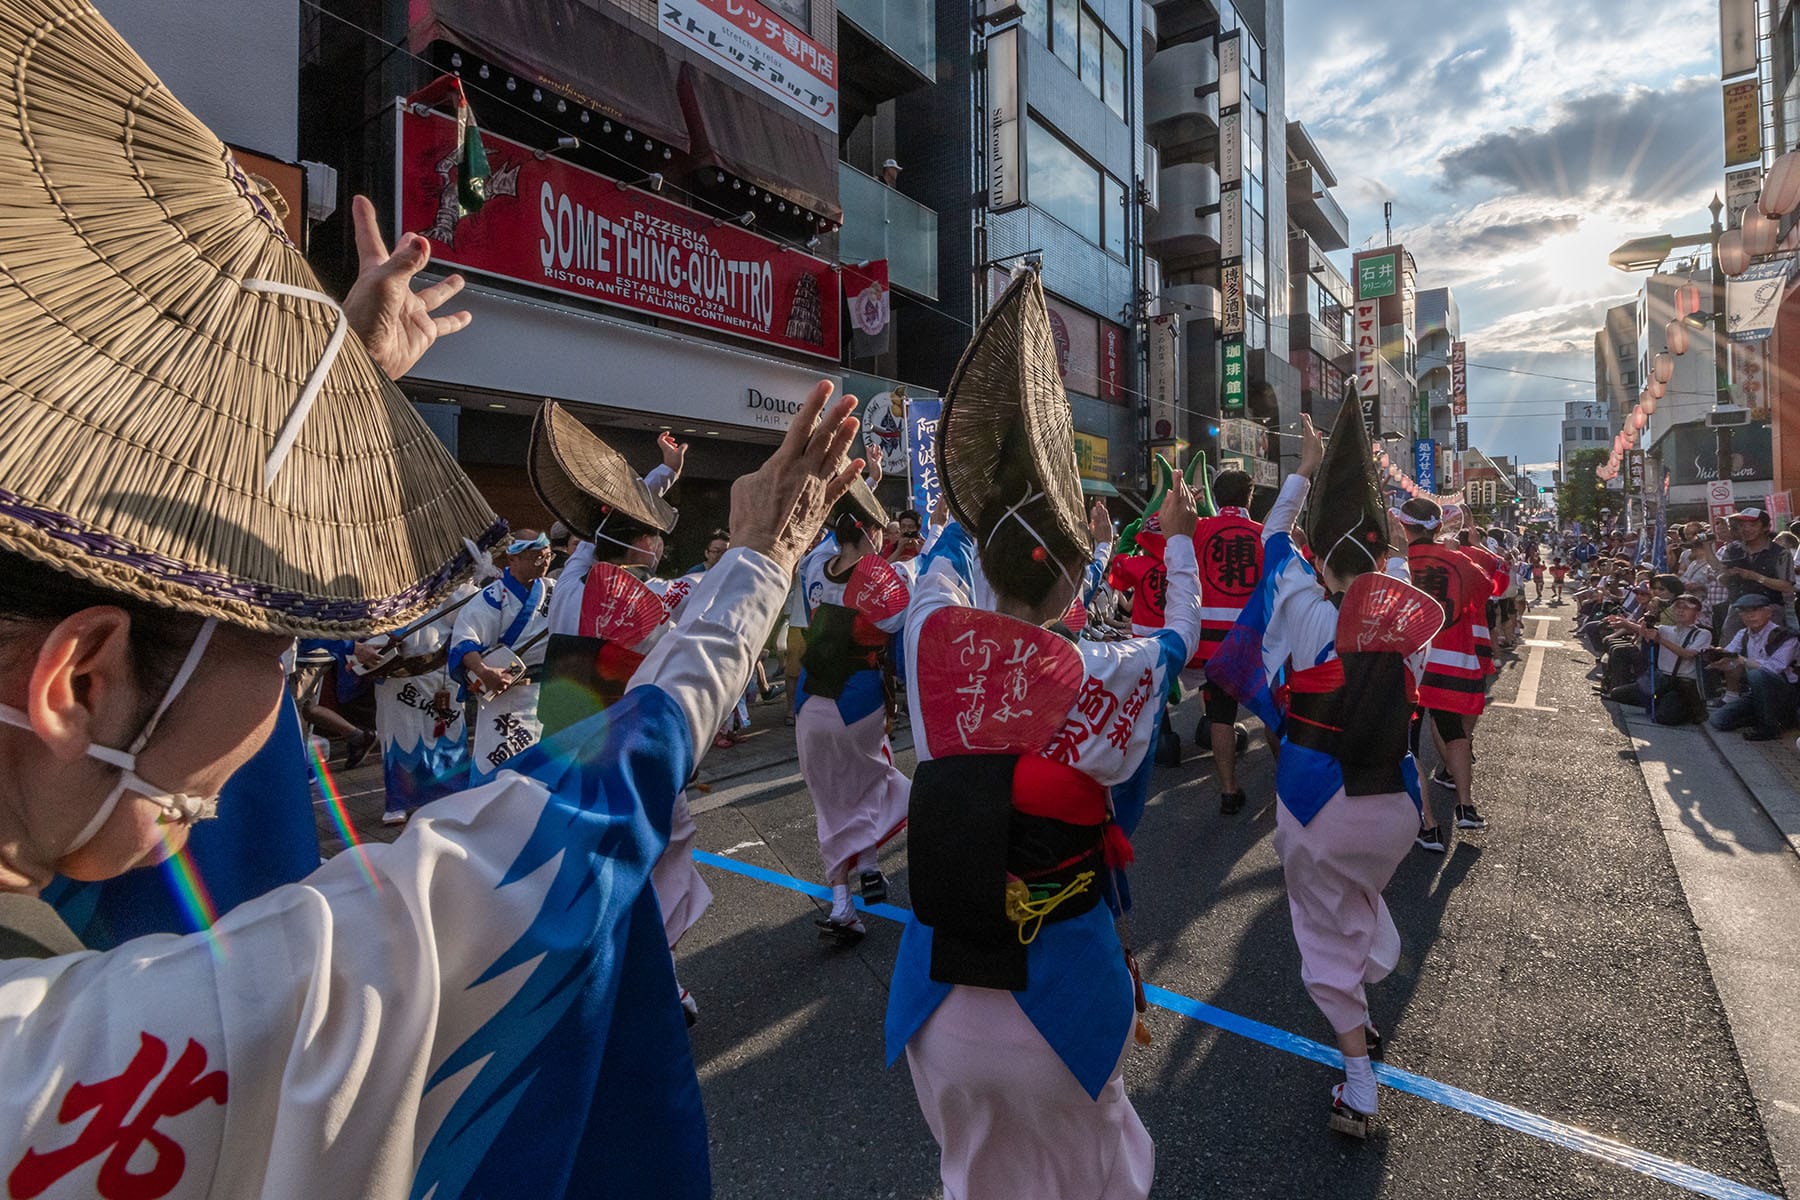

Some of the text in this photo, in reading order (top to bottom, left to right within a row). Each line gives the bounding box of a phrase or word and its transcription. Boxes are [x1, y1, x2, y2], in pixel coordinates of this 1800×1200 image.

[663, 3, 824, 106] ストレッチアップ
[711, 0, 833, 81] レッチ専門店
[721, 25, 783, 69] stretch & relax
[993, 107, 1004, 207] Silkroad VIVID
[619, 216, 721, 259] TRATTORIA
[634, 210, 710, 245] PIZZERIA
[540, 180, 774, 329] SOMETHING-QUATTRO
[1362, 263, 1393, 281] 石井
[544, 266, 771, 335] RISTORANTE ITALIANO CONTINENTALE
[615, 276, 725, 314] ESTABLISHED 1978
[1225, 267, 1240, 328] 博多酒場
[1362, 279, 1394, 292] クリニック
[1226, 345, 1242, 395] 珈琲館
[1358, 305, 1375, 392] ヤマハピアノ
[755, 414, 781, 426] HAIR
[1454, 405, 1466, 414] 5F
[916, 417, 942, 531] 阿波おど
[1419, 443, 1432, 493] 処方せん受
[1210, 534, 1259, 588] 浦和
[7, 1030, 229, 1200] 北
